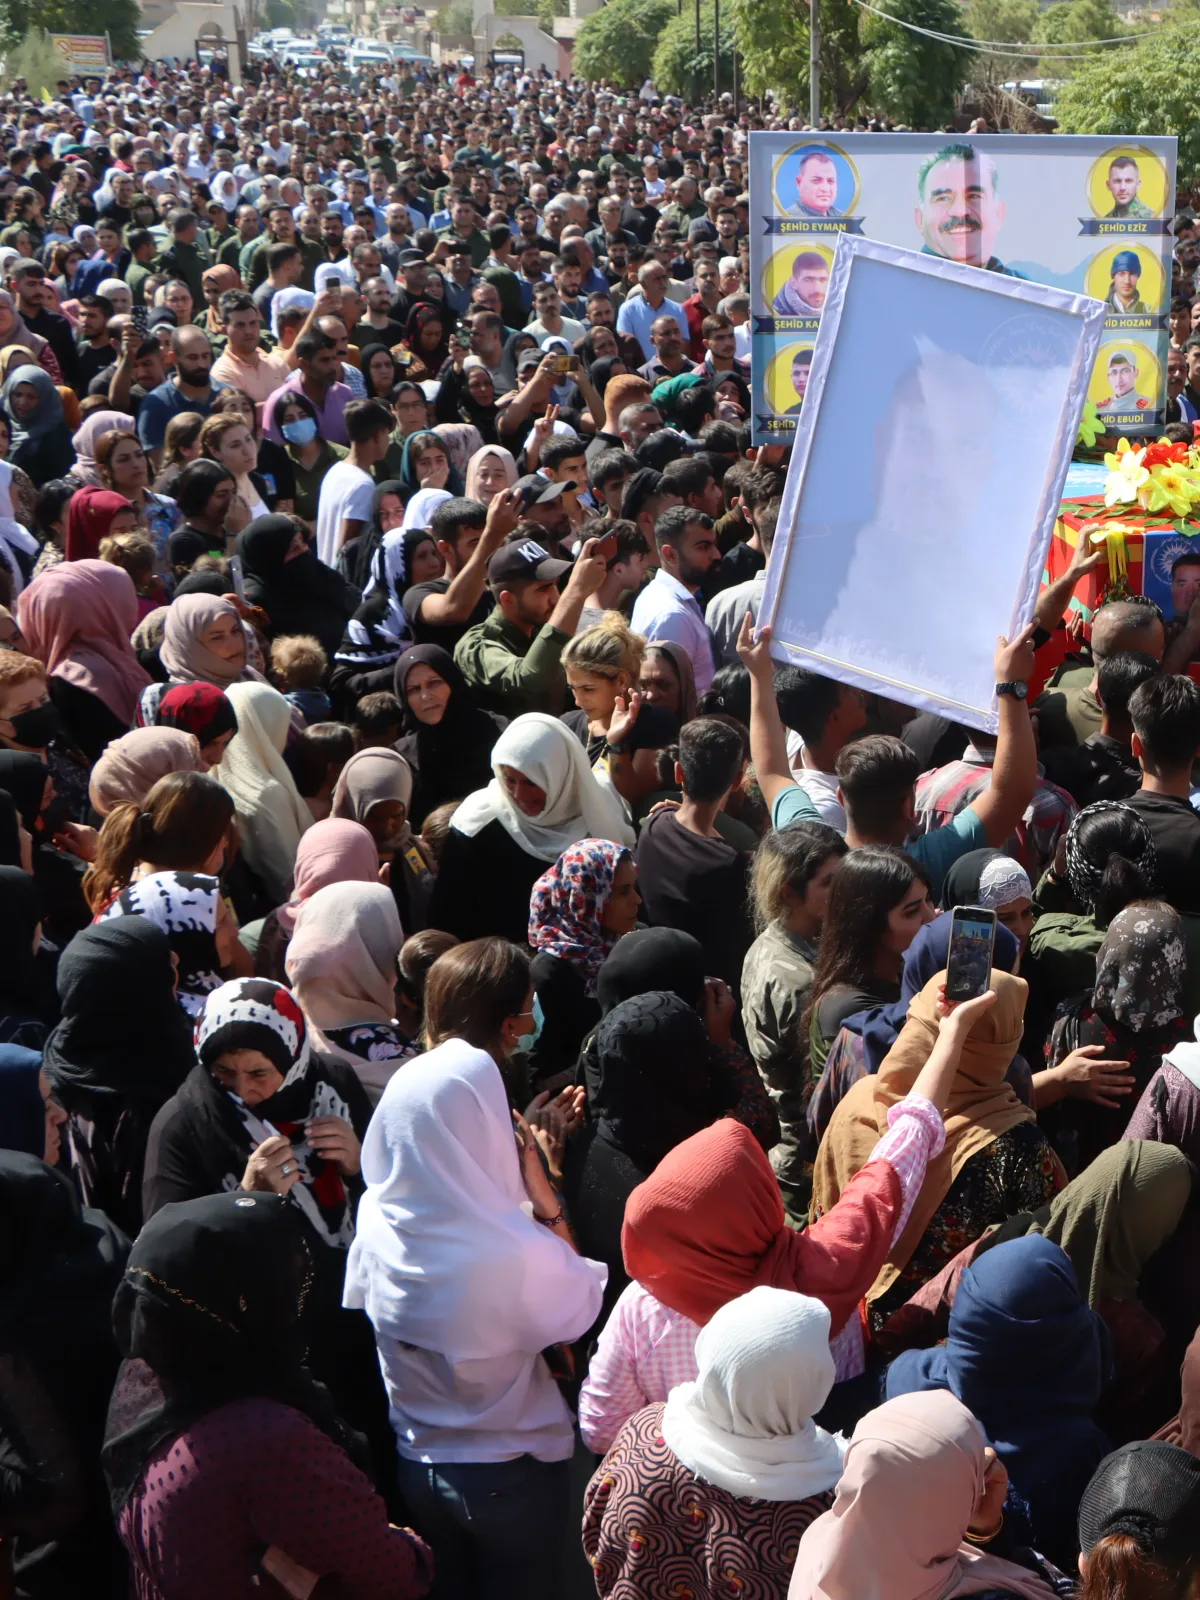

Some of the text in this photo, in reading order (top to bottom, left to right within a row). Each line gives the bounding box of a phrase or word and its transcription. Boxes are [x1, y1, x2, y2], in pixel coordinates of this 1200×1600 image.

[811, 222, 847, 231] EYMAN
[805, 320, 820, 328] KA
[1119, 318, 1152, 327] HOZAN
